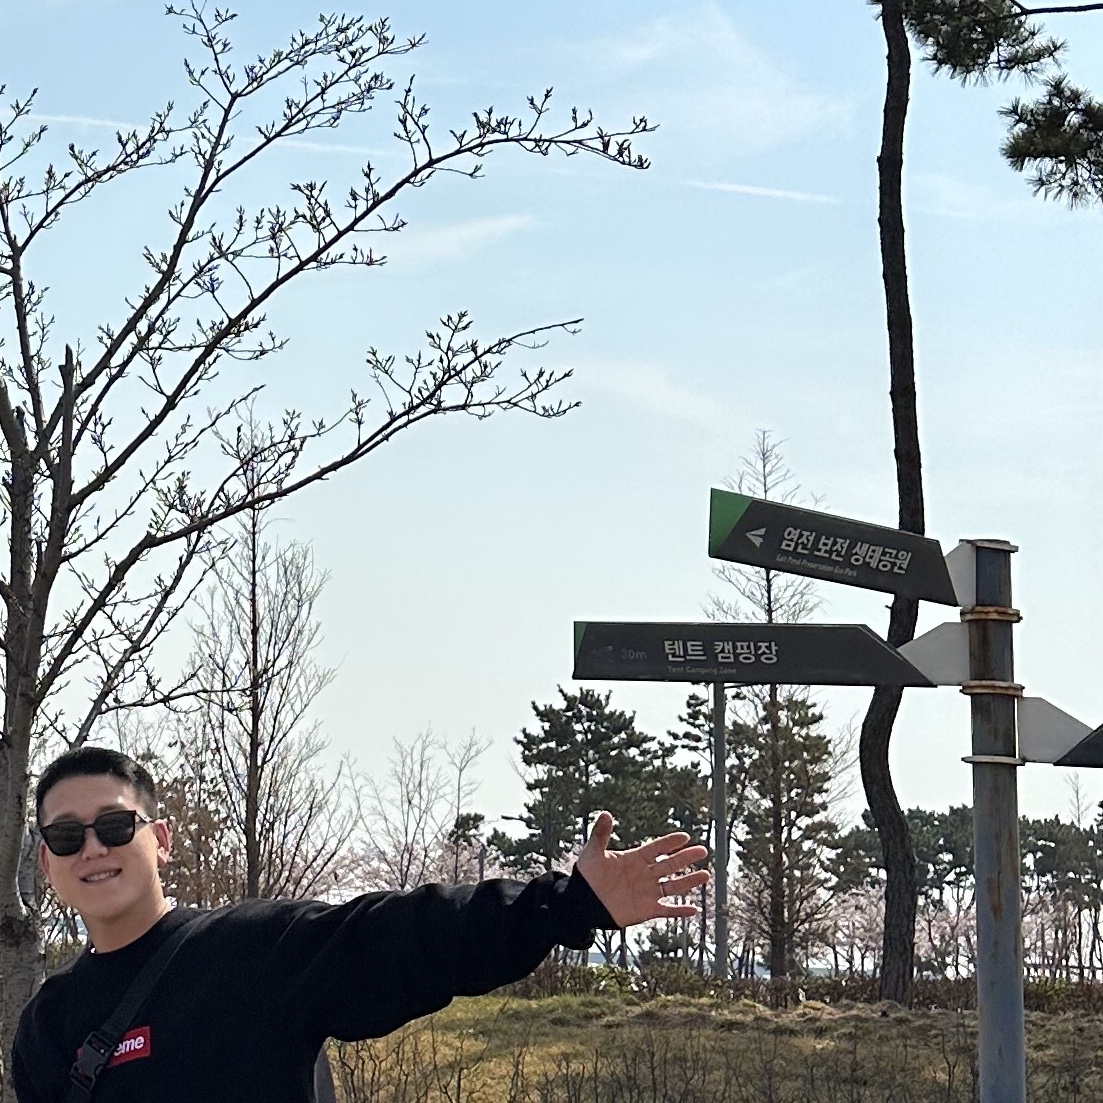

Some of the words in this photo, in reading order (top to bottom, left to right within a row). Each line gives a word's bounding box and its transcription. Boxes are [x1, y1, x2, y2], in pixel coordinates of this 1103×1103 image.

[780, 526, 816, 554] 염전
[813, 534, 850, 562] 보전
[850, 541, 912, 575] 생태공원
[663, 640, 707, 662] 텐트
[713, 640, 779, 664] 캠핑장
